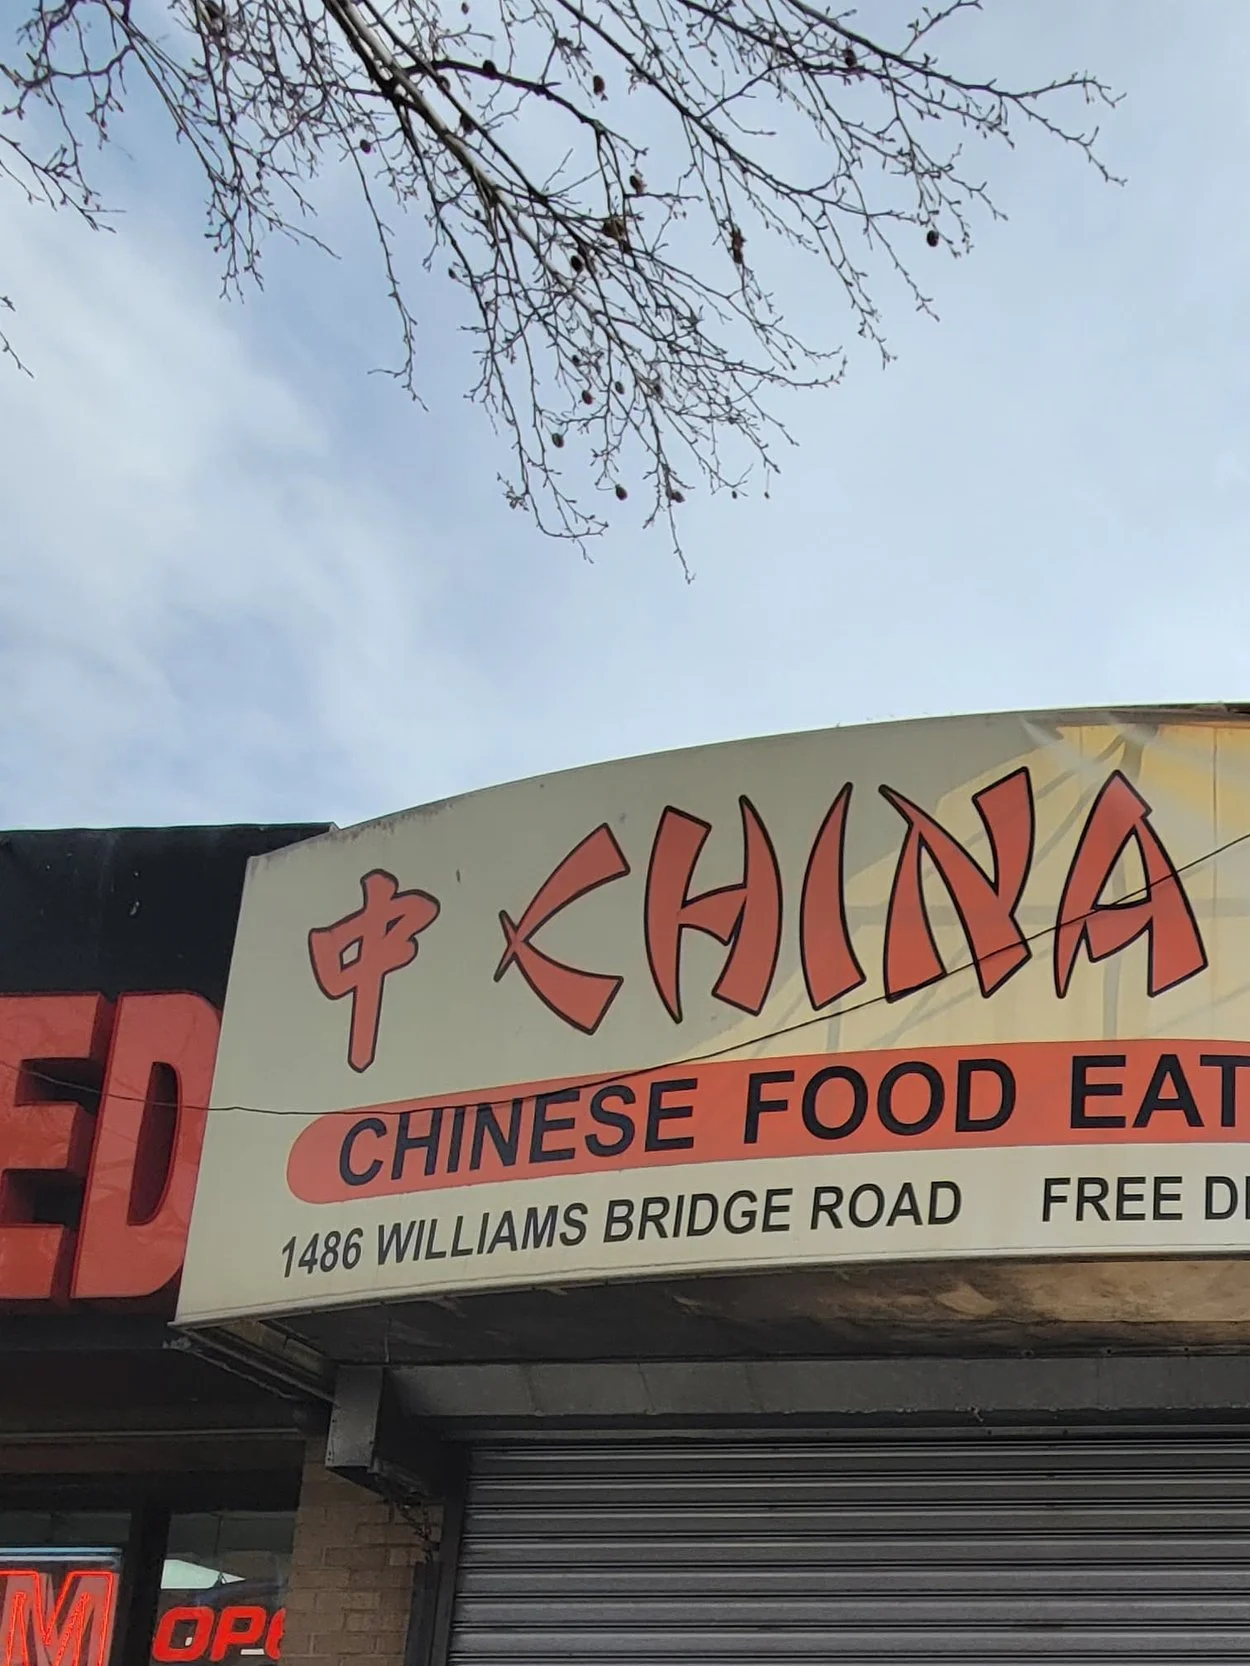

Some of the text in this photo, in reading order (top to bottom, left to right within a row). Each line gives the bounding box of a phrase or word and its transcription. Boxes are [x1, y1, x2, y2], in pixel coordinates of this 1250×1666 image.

[308, 869, 441, 1074] 中
[493, 766, 1208, 1036] CHINA
[337, 1077, 698, 1187] CHINESE
[743, 1057, 1016, 1145] FOOD
[279, 1226, 363, 1279] 1486
[374, 1204, 589, 1267] WILLIAMS
[602, 1187, 793, 1243] BRIDGE
[809, 1180, 962, 1229] ROAD
[1041, 1177, 1183, 1223] FREE
